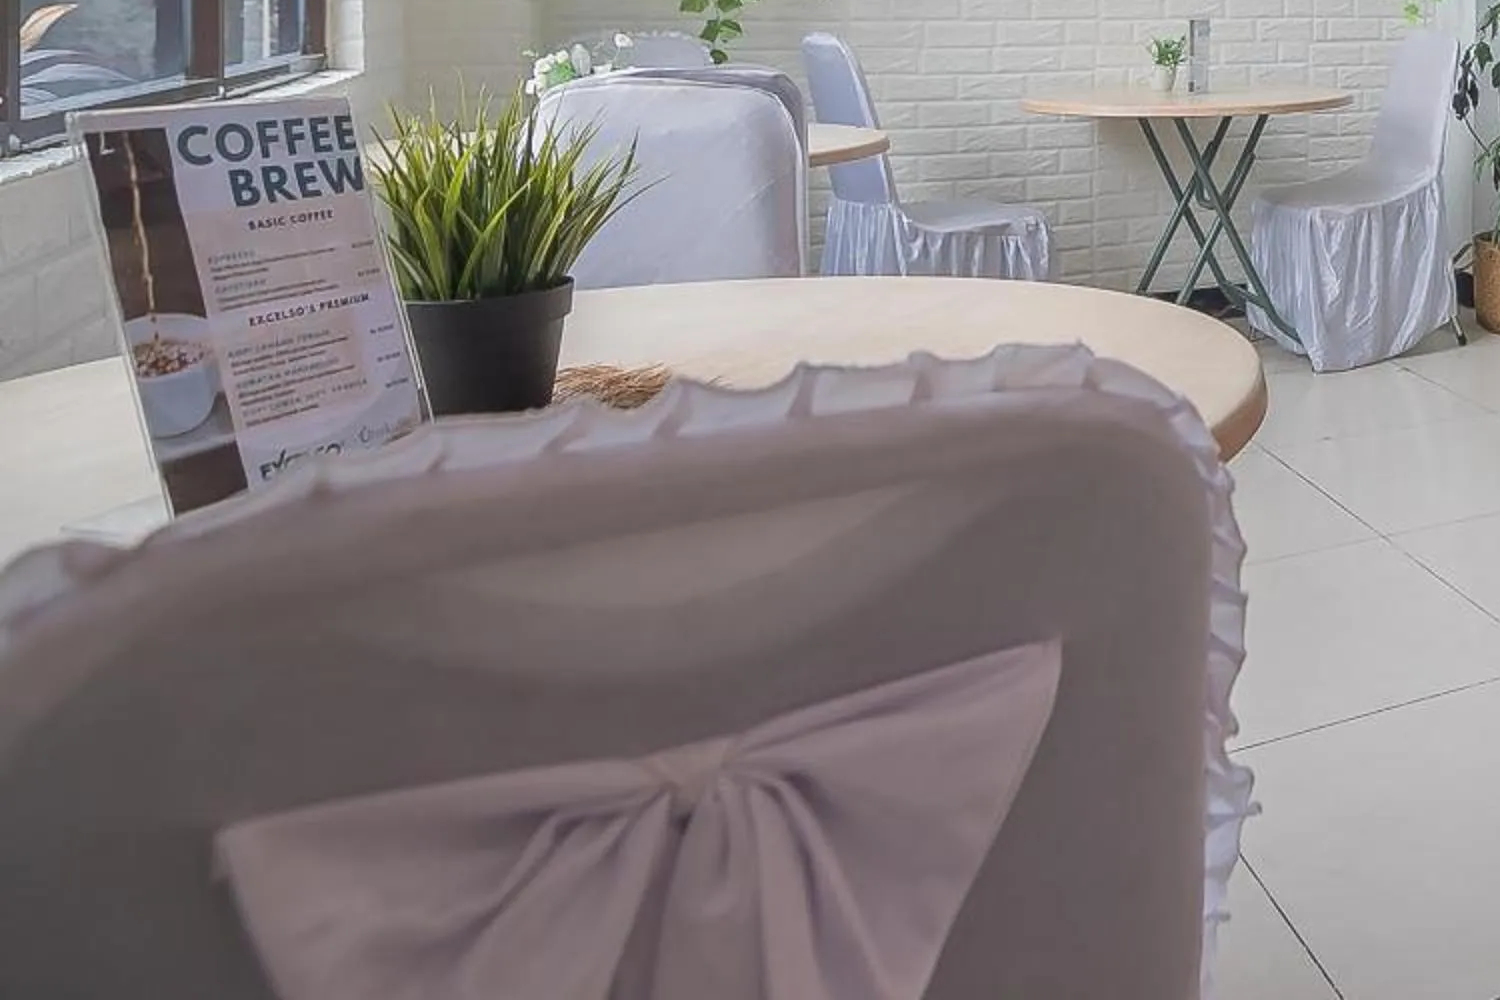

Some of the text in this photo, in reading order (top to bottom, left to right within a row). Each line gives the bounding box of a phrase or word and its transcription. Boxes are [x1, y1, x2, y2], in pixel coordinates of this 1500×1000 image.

[177, 115, 357, 166] COFFEE
[228, 155, 365, 208] BREW
[248, 209, 334, 231] BASIC COFFEE
[319, 293, 370, 311] PREMIUM
